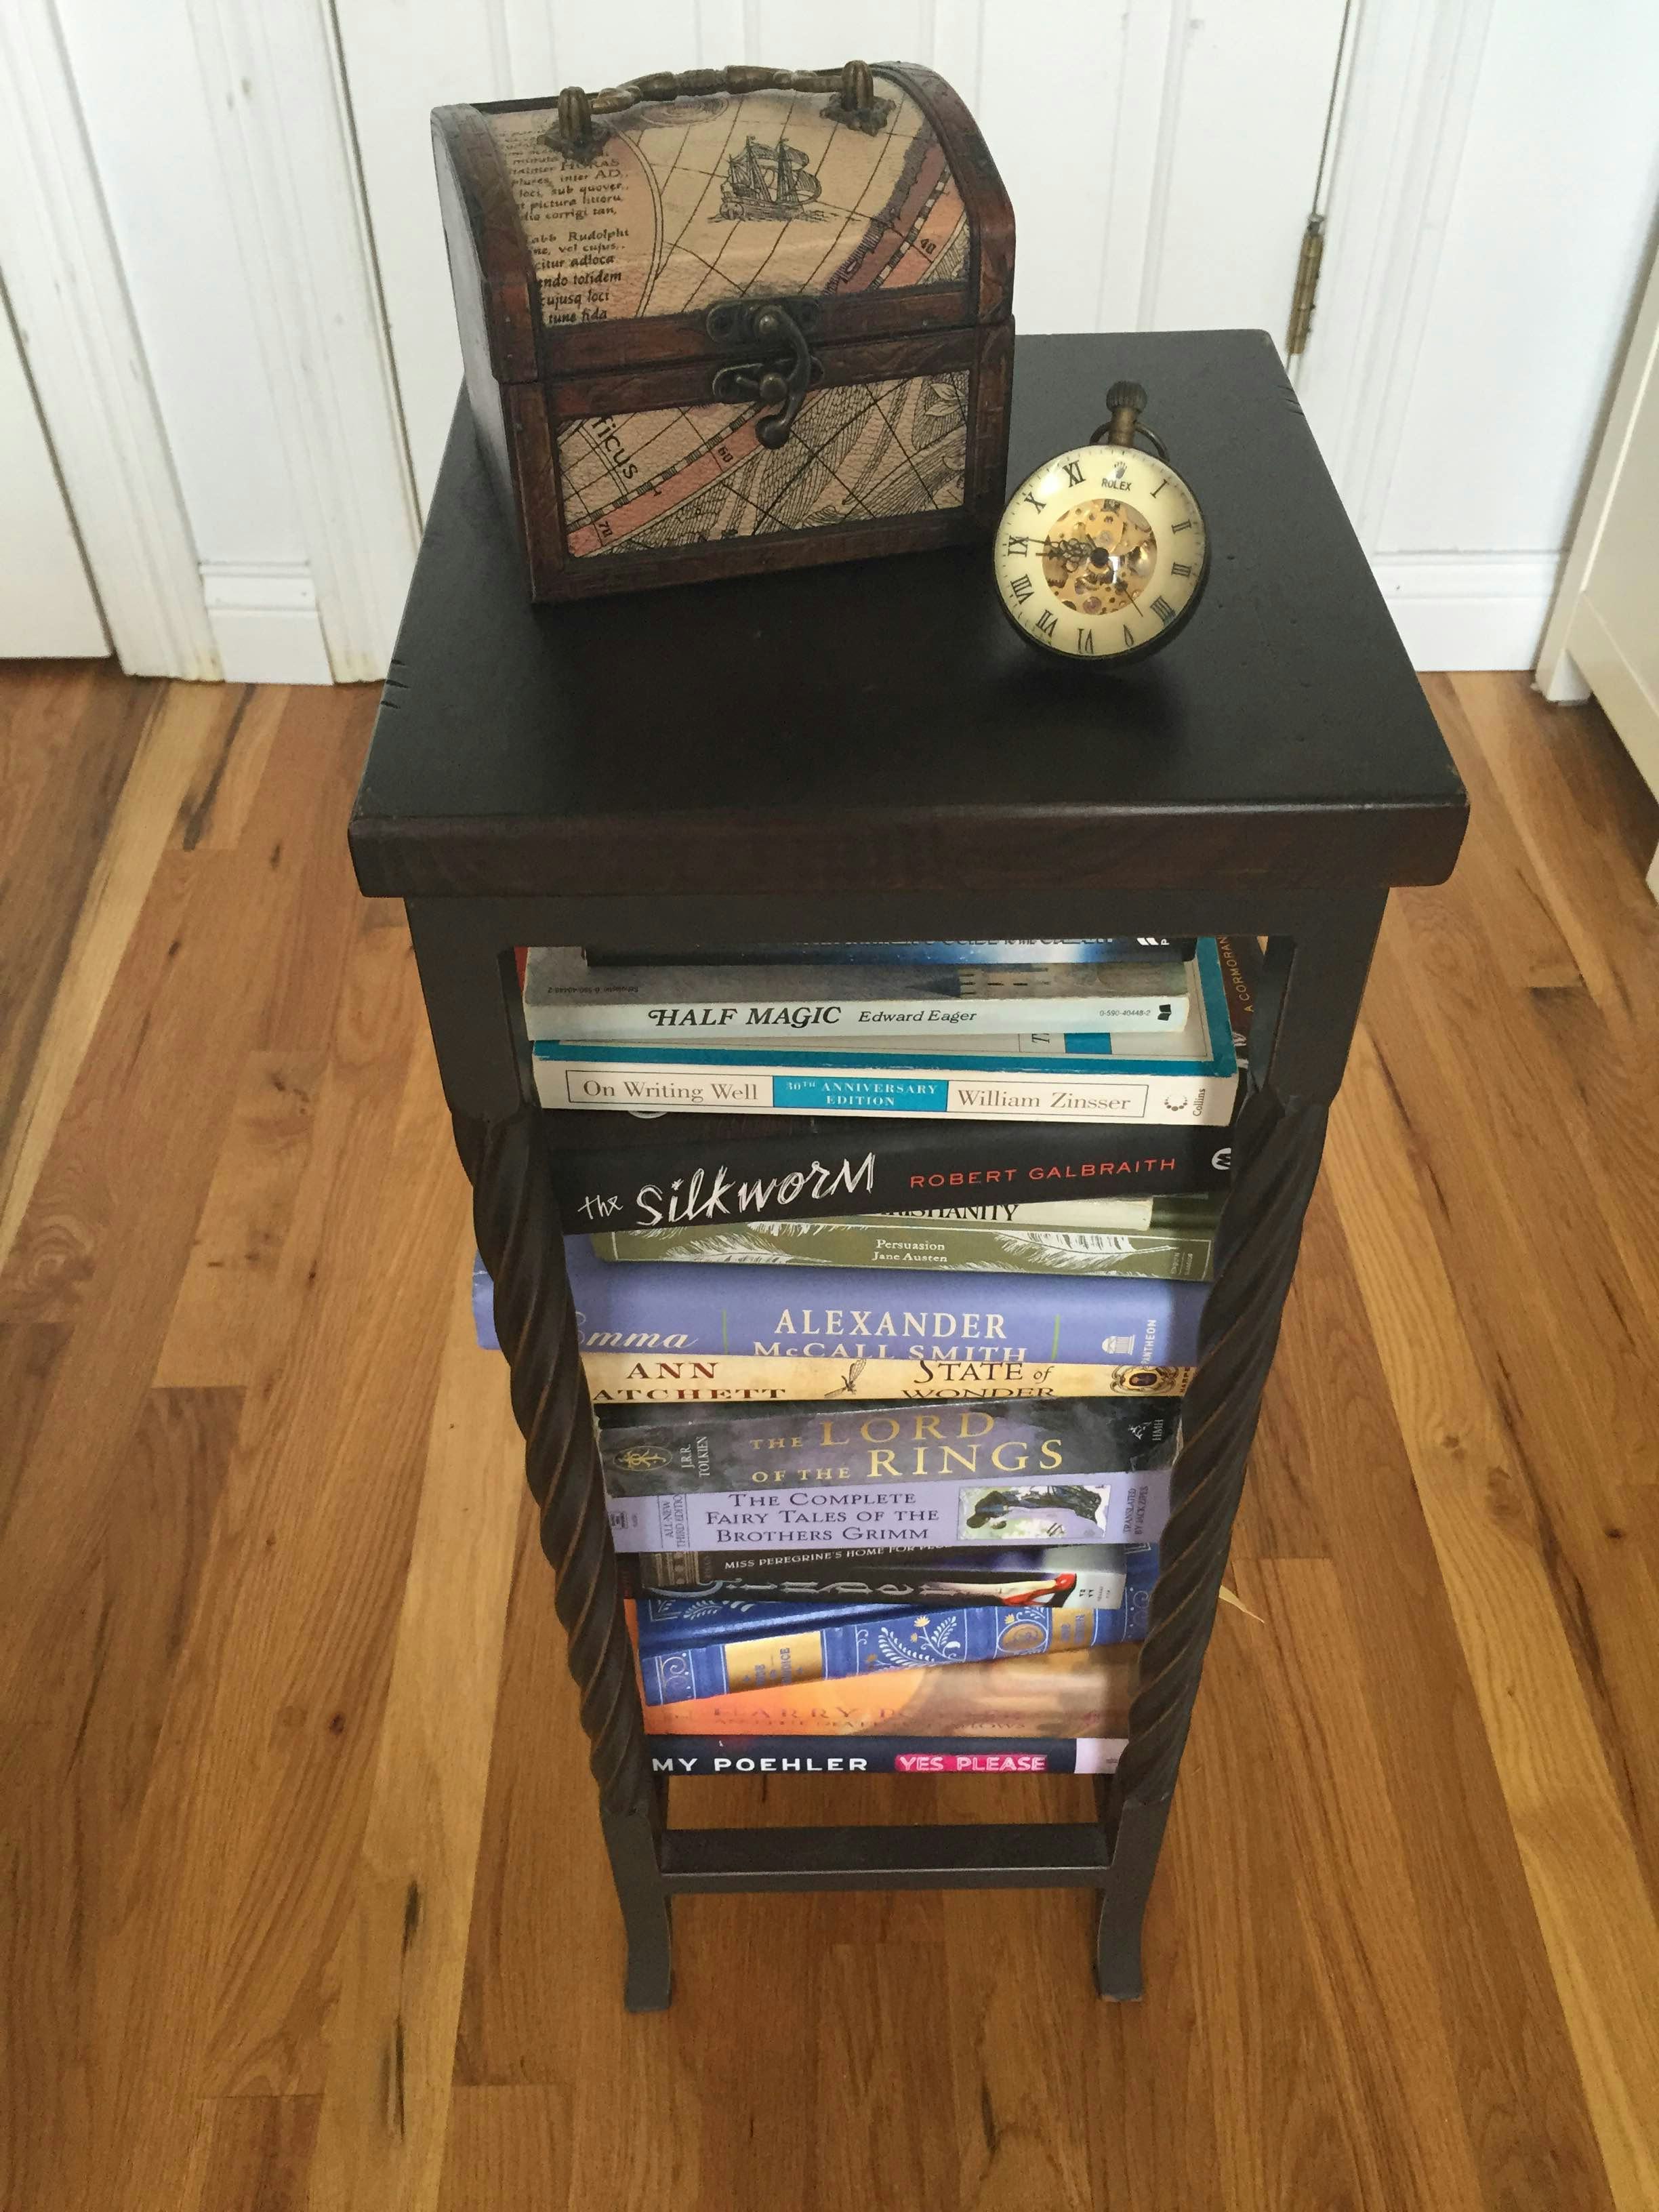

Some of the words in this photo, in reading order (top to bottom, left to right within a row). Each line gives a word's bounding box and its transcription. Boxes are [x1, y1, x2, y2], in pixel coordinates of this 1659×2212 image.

[551, 185, 574, 195] sub
[568, 228, 629, 242] Rudolphi
[920, 238, 937, 255] 40
[1063, 459, 1086, 488] XI
[1101, 477, 1132, 492] ROLEX
[647, 1008, 738, 1027] HALF
[745, 1006, 842, 1029] MAGIC
[858, 1010, 925, 1023] Edward
[927, 1009, 977, 1025] Eager
[583, 1080, 615, 1097] On
[623, 1080, 704, 1103] Writing
[711, 1082, 759, 1101] Well
[821, 1082, 938, 1095] ANNIVERSARY
[826, 1094, 895, 1107] EDITION
[958, 1088, 1041, 1108] William
[1050, 1091, 1132, 1111] Zinsser
[1192, 1088, 1206, 1117] Collins
[909, 1168, 1018, 1189] ROBERT
[1028, 1158, 1176, 1181] GALBRAITH
[876, 1239, 945, 1251] Persuasion
[872, 1251, 901, 1261] Jane
[902, 1252, 948, 1263] Austen
[576, 1311, 699, 1349] mma
[775, 1309, 1007, 1340] ALEXANDER
[909, 1345, 1027, 1362] SMITH
[626, 1362, 718, 1380] ANN
[913, 1359, 1024, 1385] STATE
[1033, 1366, 1055, 1385] of
[593, 1389, 785, 1401] ATCHETT
[900, 1387, 1055, 1398] WONDER
[750, 1437, 804, 1450] THE
[820, 1411, 996, 1448] LORD
[698, 1435, 711, 1478] TOLKIEN
[752, 1469, 786, 1483] OF
[797, 1466, 851, 1481] THE
[866, 1438, 1065, 1479] RINGS
[729, 1492, 781, 1507] THE
[789, 1491, 917, 1507] COMPLETE
[706, 1511, 769, 1526] FAIRY
[779, 1509, 847, 1524] TALES
[856, 1510, 885, 1523] OF
[894, 1509, 941, 1522] THE
[716, 1528, 833, 1543] BROTHERS
[842, 1526, 929, 1542] GRIMM
[724, 1559, 755, 1570] MISS
[759, 1549, 842, 1566] PEREGRINE'S
[846, 1547, 884, 1558] HOME
[652, 1757, 698, 1771] MY
[714, 1757, 868, 1771] POEHLER
[899, 1756, 945, 1771] YES
[956, 1755, 1047, 1771] PLEASE
